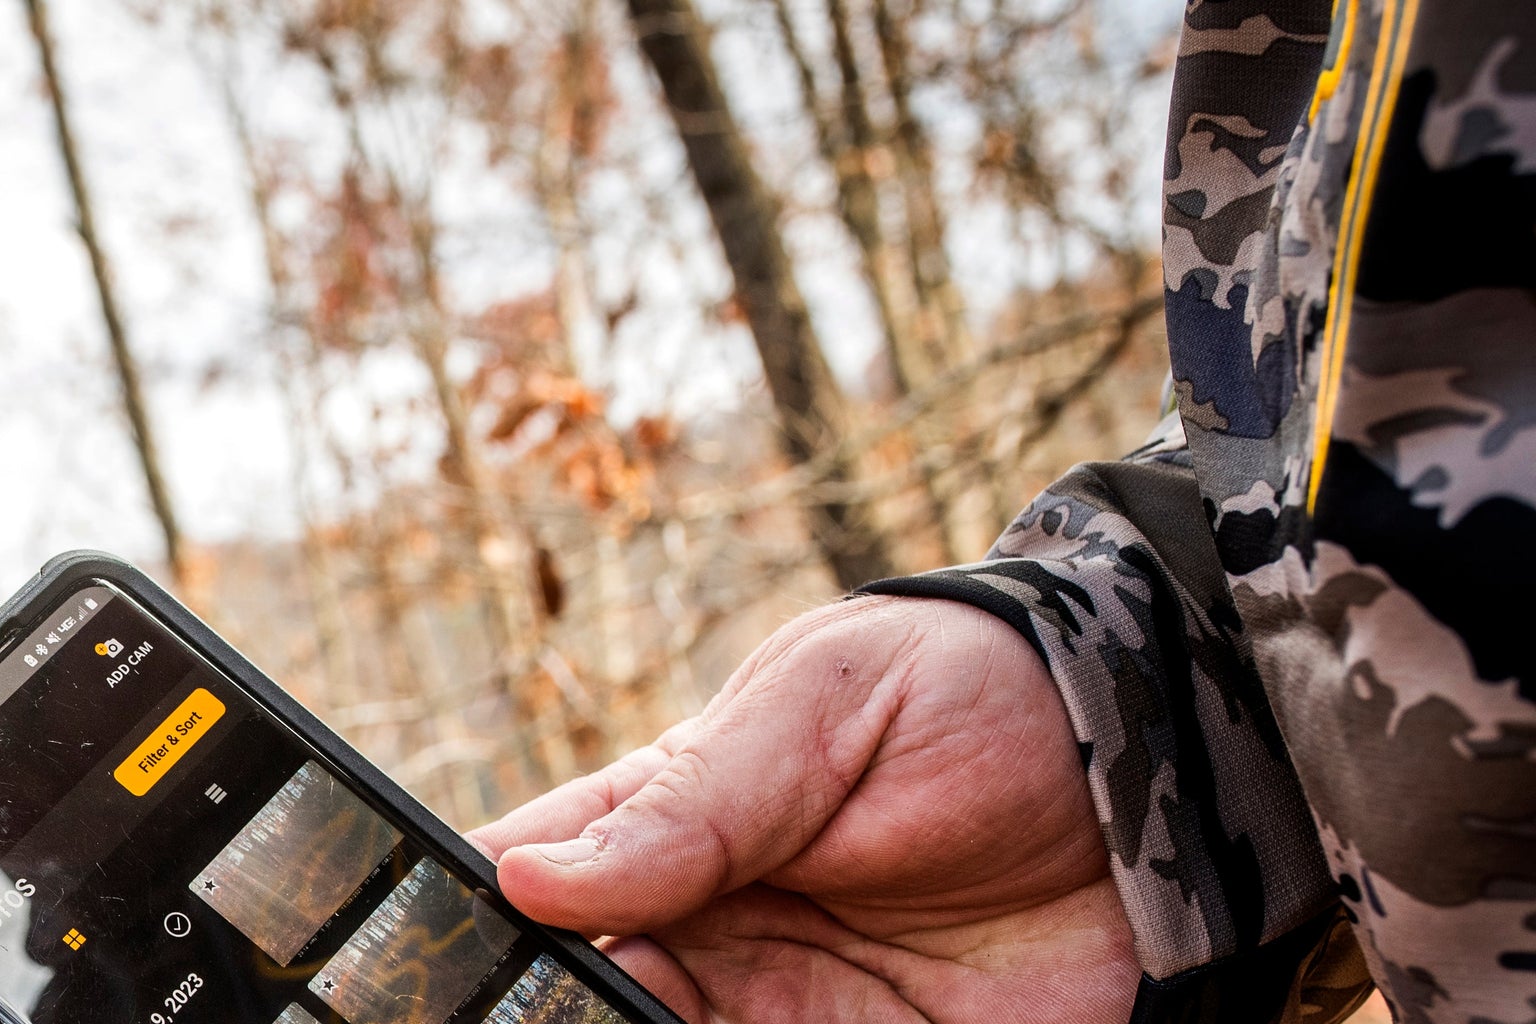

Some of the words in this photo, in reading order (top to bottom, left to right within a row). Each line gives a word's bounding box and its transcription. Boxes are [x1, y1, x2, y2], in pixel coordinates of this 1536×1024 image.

[105, 663, 130, 688] ADD
[128, 641, 154, 665] CAM
[138, 743, 170, 773] Filter
[166, 734, 180, 746] &
[175, 711, 203, 736] Sort
[164, 972, 204, 1014] 2023
